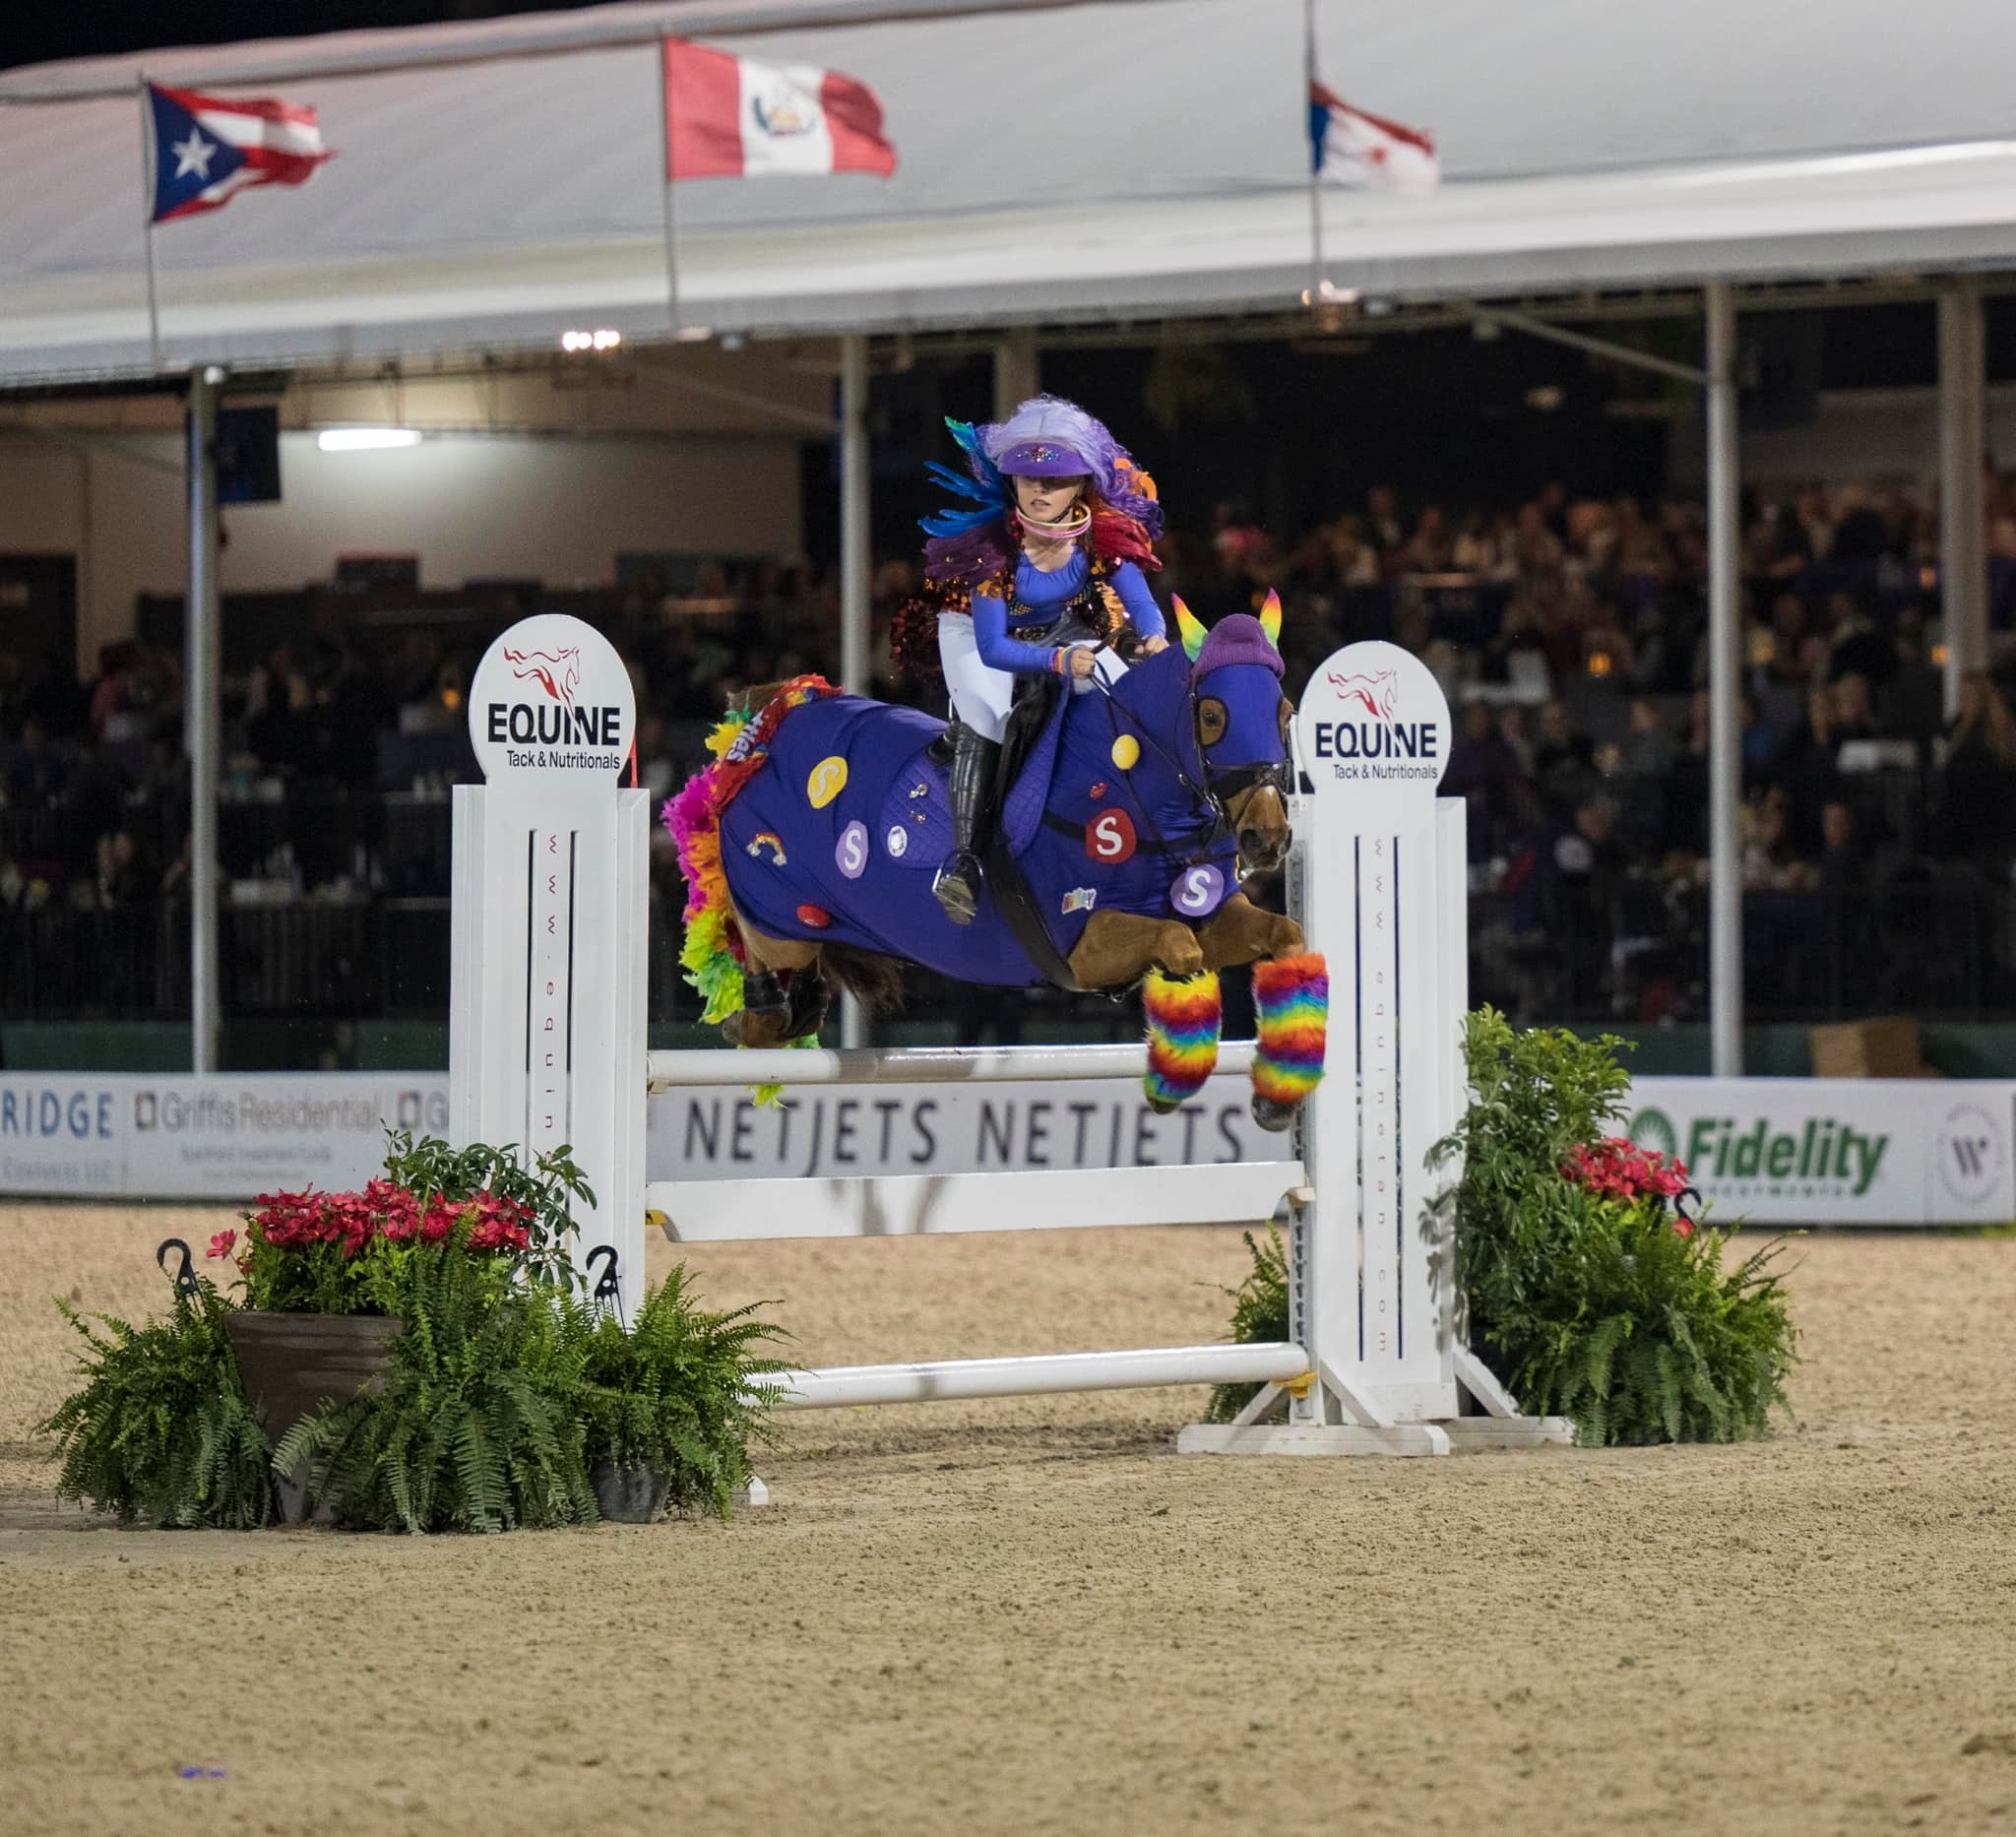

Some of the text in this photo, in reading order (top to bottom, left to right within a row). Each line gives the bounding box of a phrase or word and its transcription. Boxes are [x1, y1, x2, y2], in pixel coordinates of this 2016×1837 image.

[488, 702, 620, 746] EQUINE
[1315, 723, 1437, 758] EQUINE
[507, 749, 620, 769] Tack & Nutritionals
[1333, 764, 1438, 780] Tack & Nutritionals
[811, 763, 840, 798] S
[844, 829, 862, 870] S
[1096, 816, 1123, 855] S
[1181, 869, 1212, 908] S
[2, 1090, 113, 1139] RIDGE
[685, 1097, 1244, 1178] NETJETS NETJETS
[1687, 1116, 1890, 1197] Fidelity
